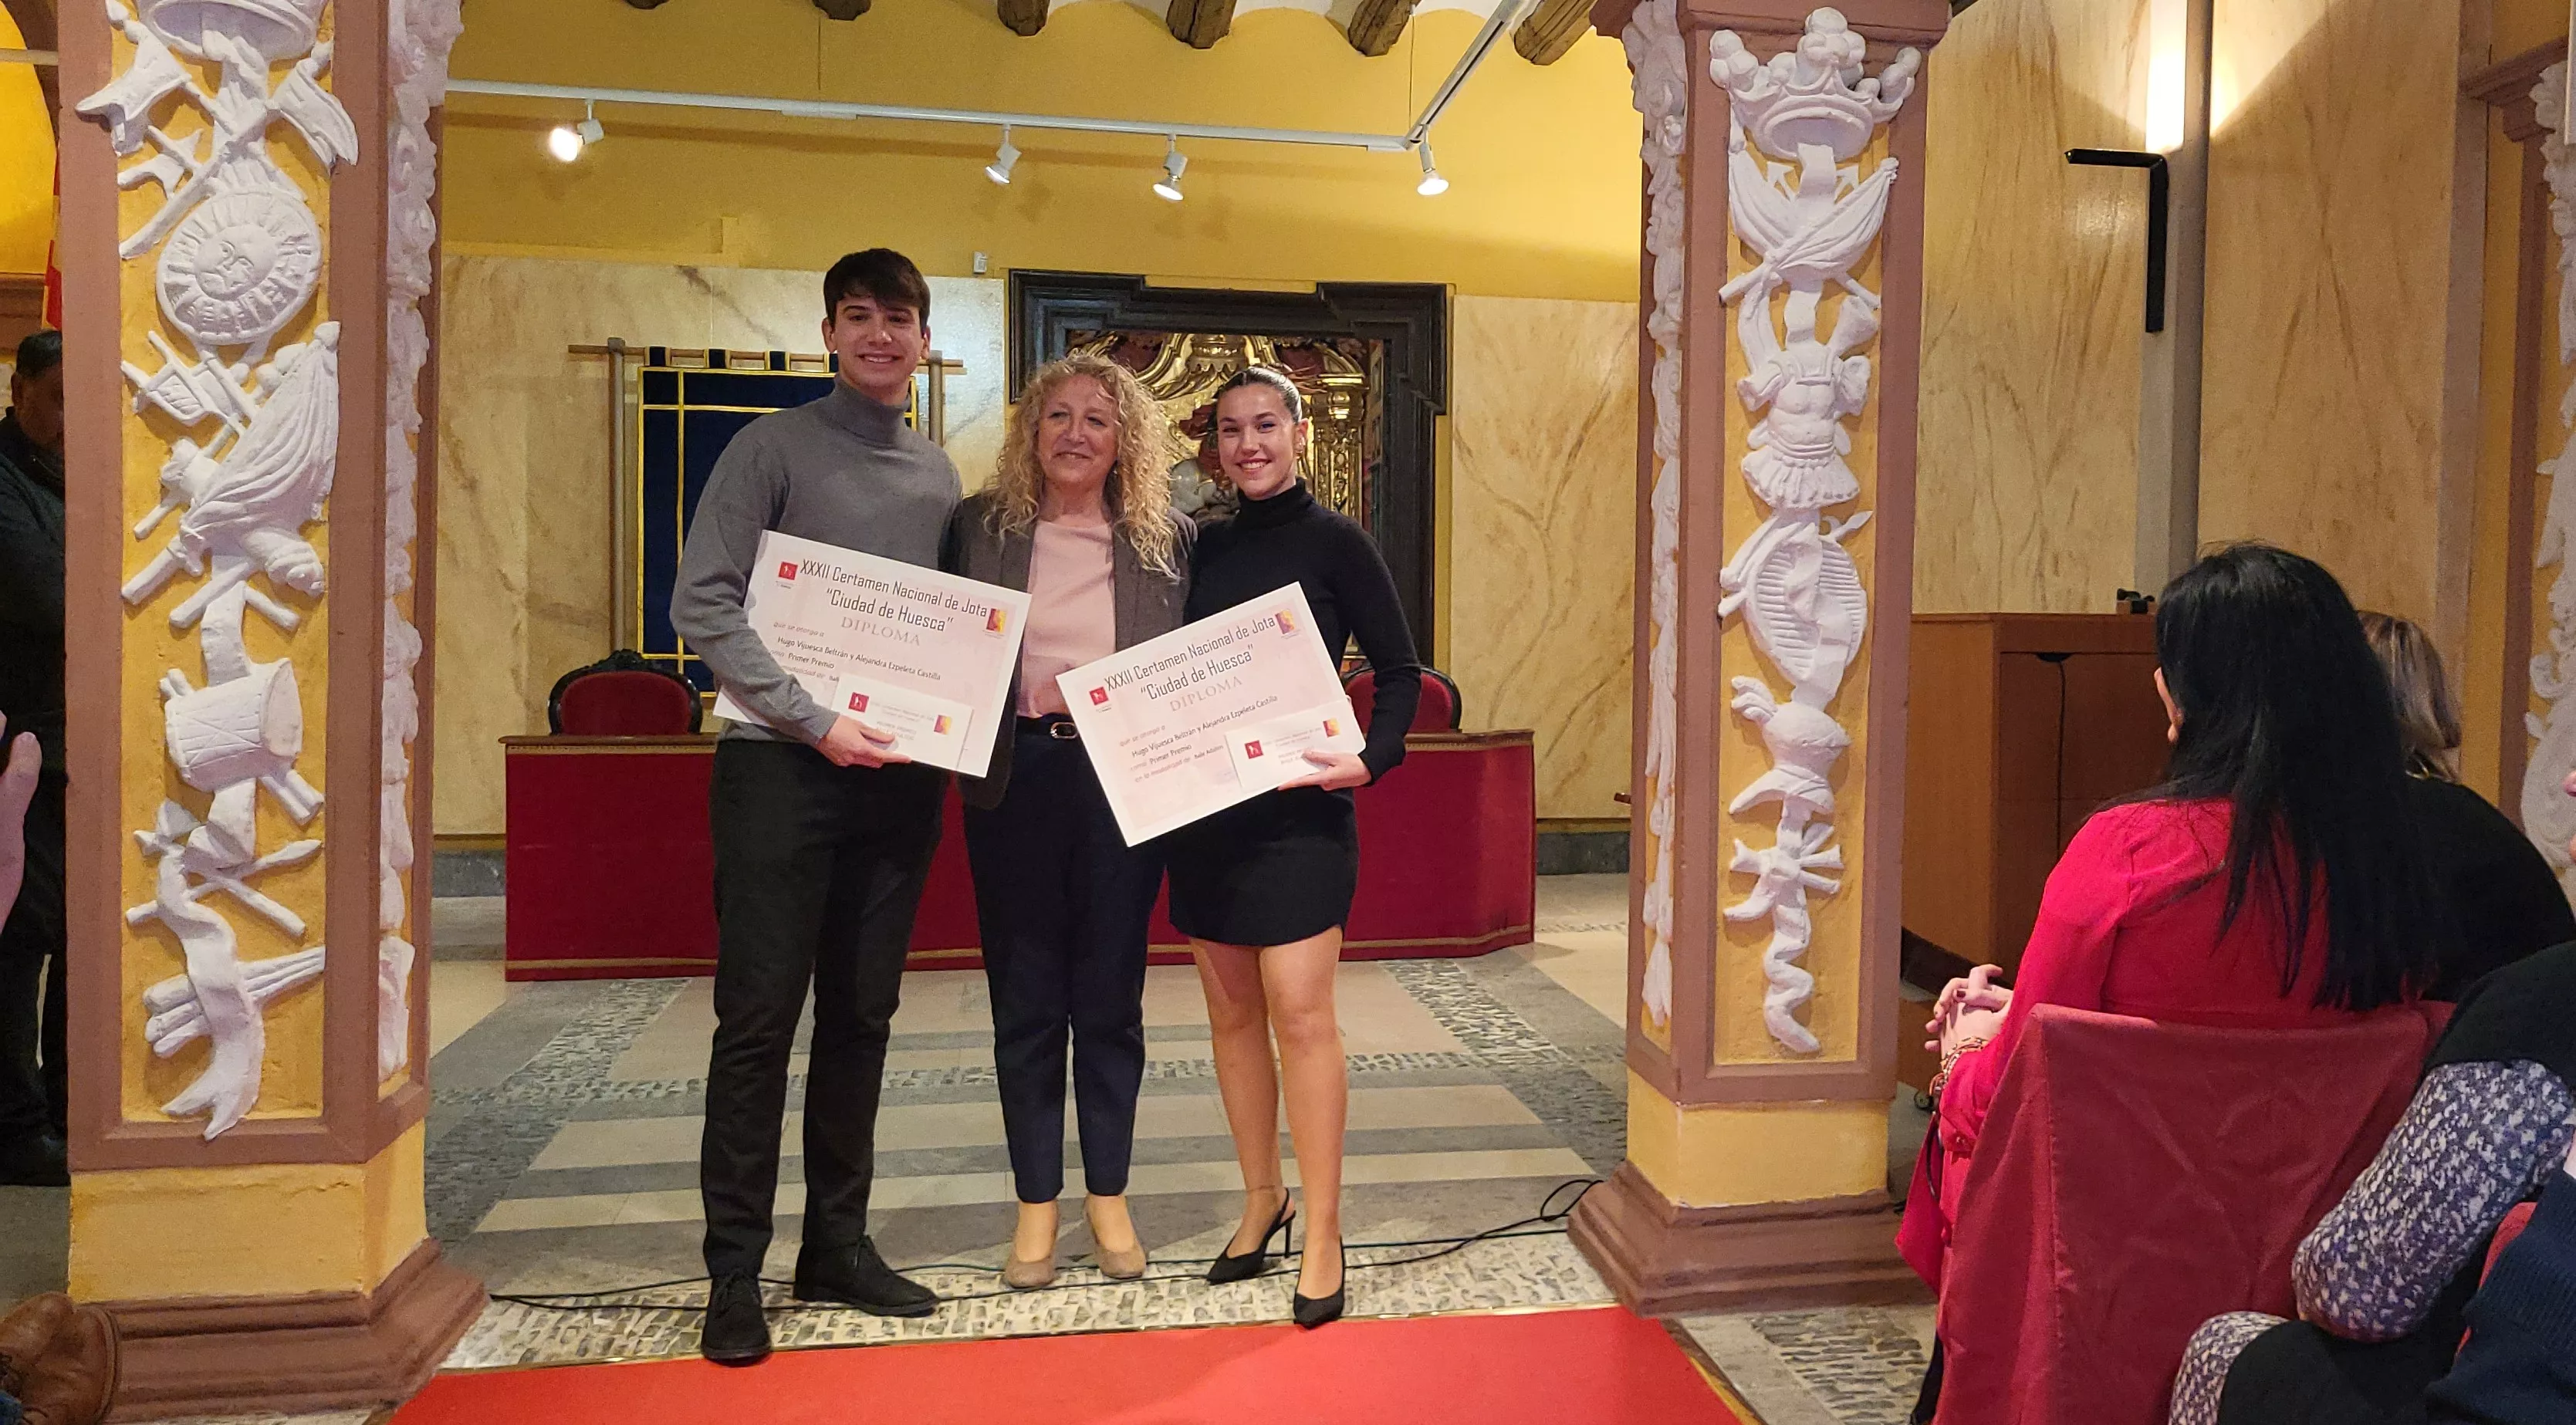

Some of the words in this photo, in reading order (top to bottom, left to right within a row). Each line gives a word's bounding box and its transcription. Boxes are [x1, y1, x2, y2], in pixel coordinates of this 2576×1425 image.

[800, 559, 830, 579] XXXII
[833, 566, 889, 593] Certamen
[892, 581, 943, 606] Nacional
[945, 594, 958, 610] de
[961, 599, 988, 617] Jota
[878, 602, 894, 619] de
[841, 616, 920, 647] DIPLOMA
[777, 636, 796, 648] Hugo
[855, 653, 887, 668] Alejandra
[788, 653, 810, 664] Primer
[811, 657, 835, 669] Premio
[1104, 669, 1134, 691] XXXII
[1133, 653, 1188, 680] Certamen
[1187, 629, 1235, 659] Nacional
[1236, 625, 1249, 640] de
[1252, 617, 1276, 634] Jota
[1191, 667, 1206, 683] de
[1170, 676, 1242, 711] DIPLOMA
[1131, 747, 1149, 758] Hugo
[1202, 714, 1230, 731] Alejandra
[1149, 753, 1169, 765] Primer
[1170, 745, 1192, 756] Premio
